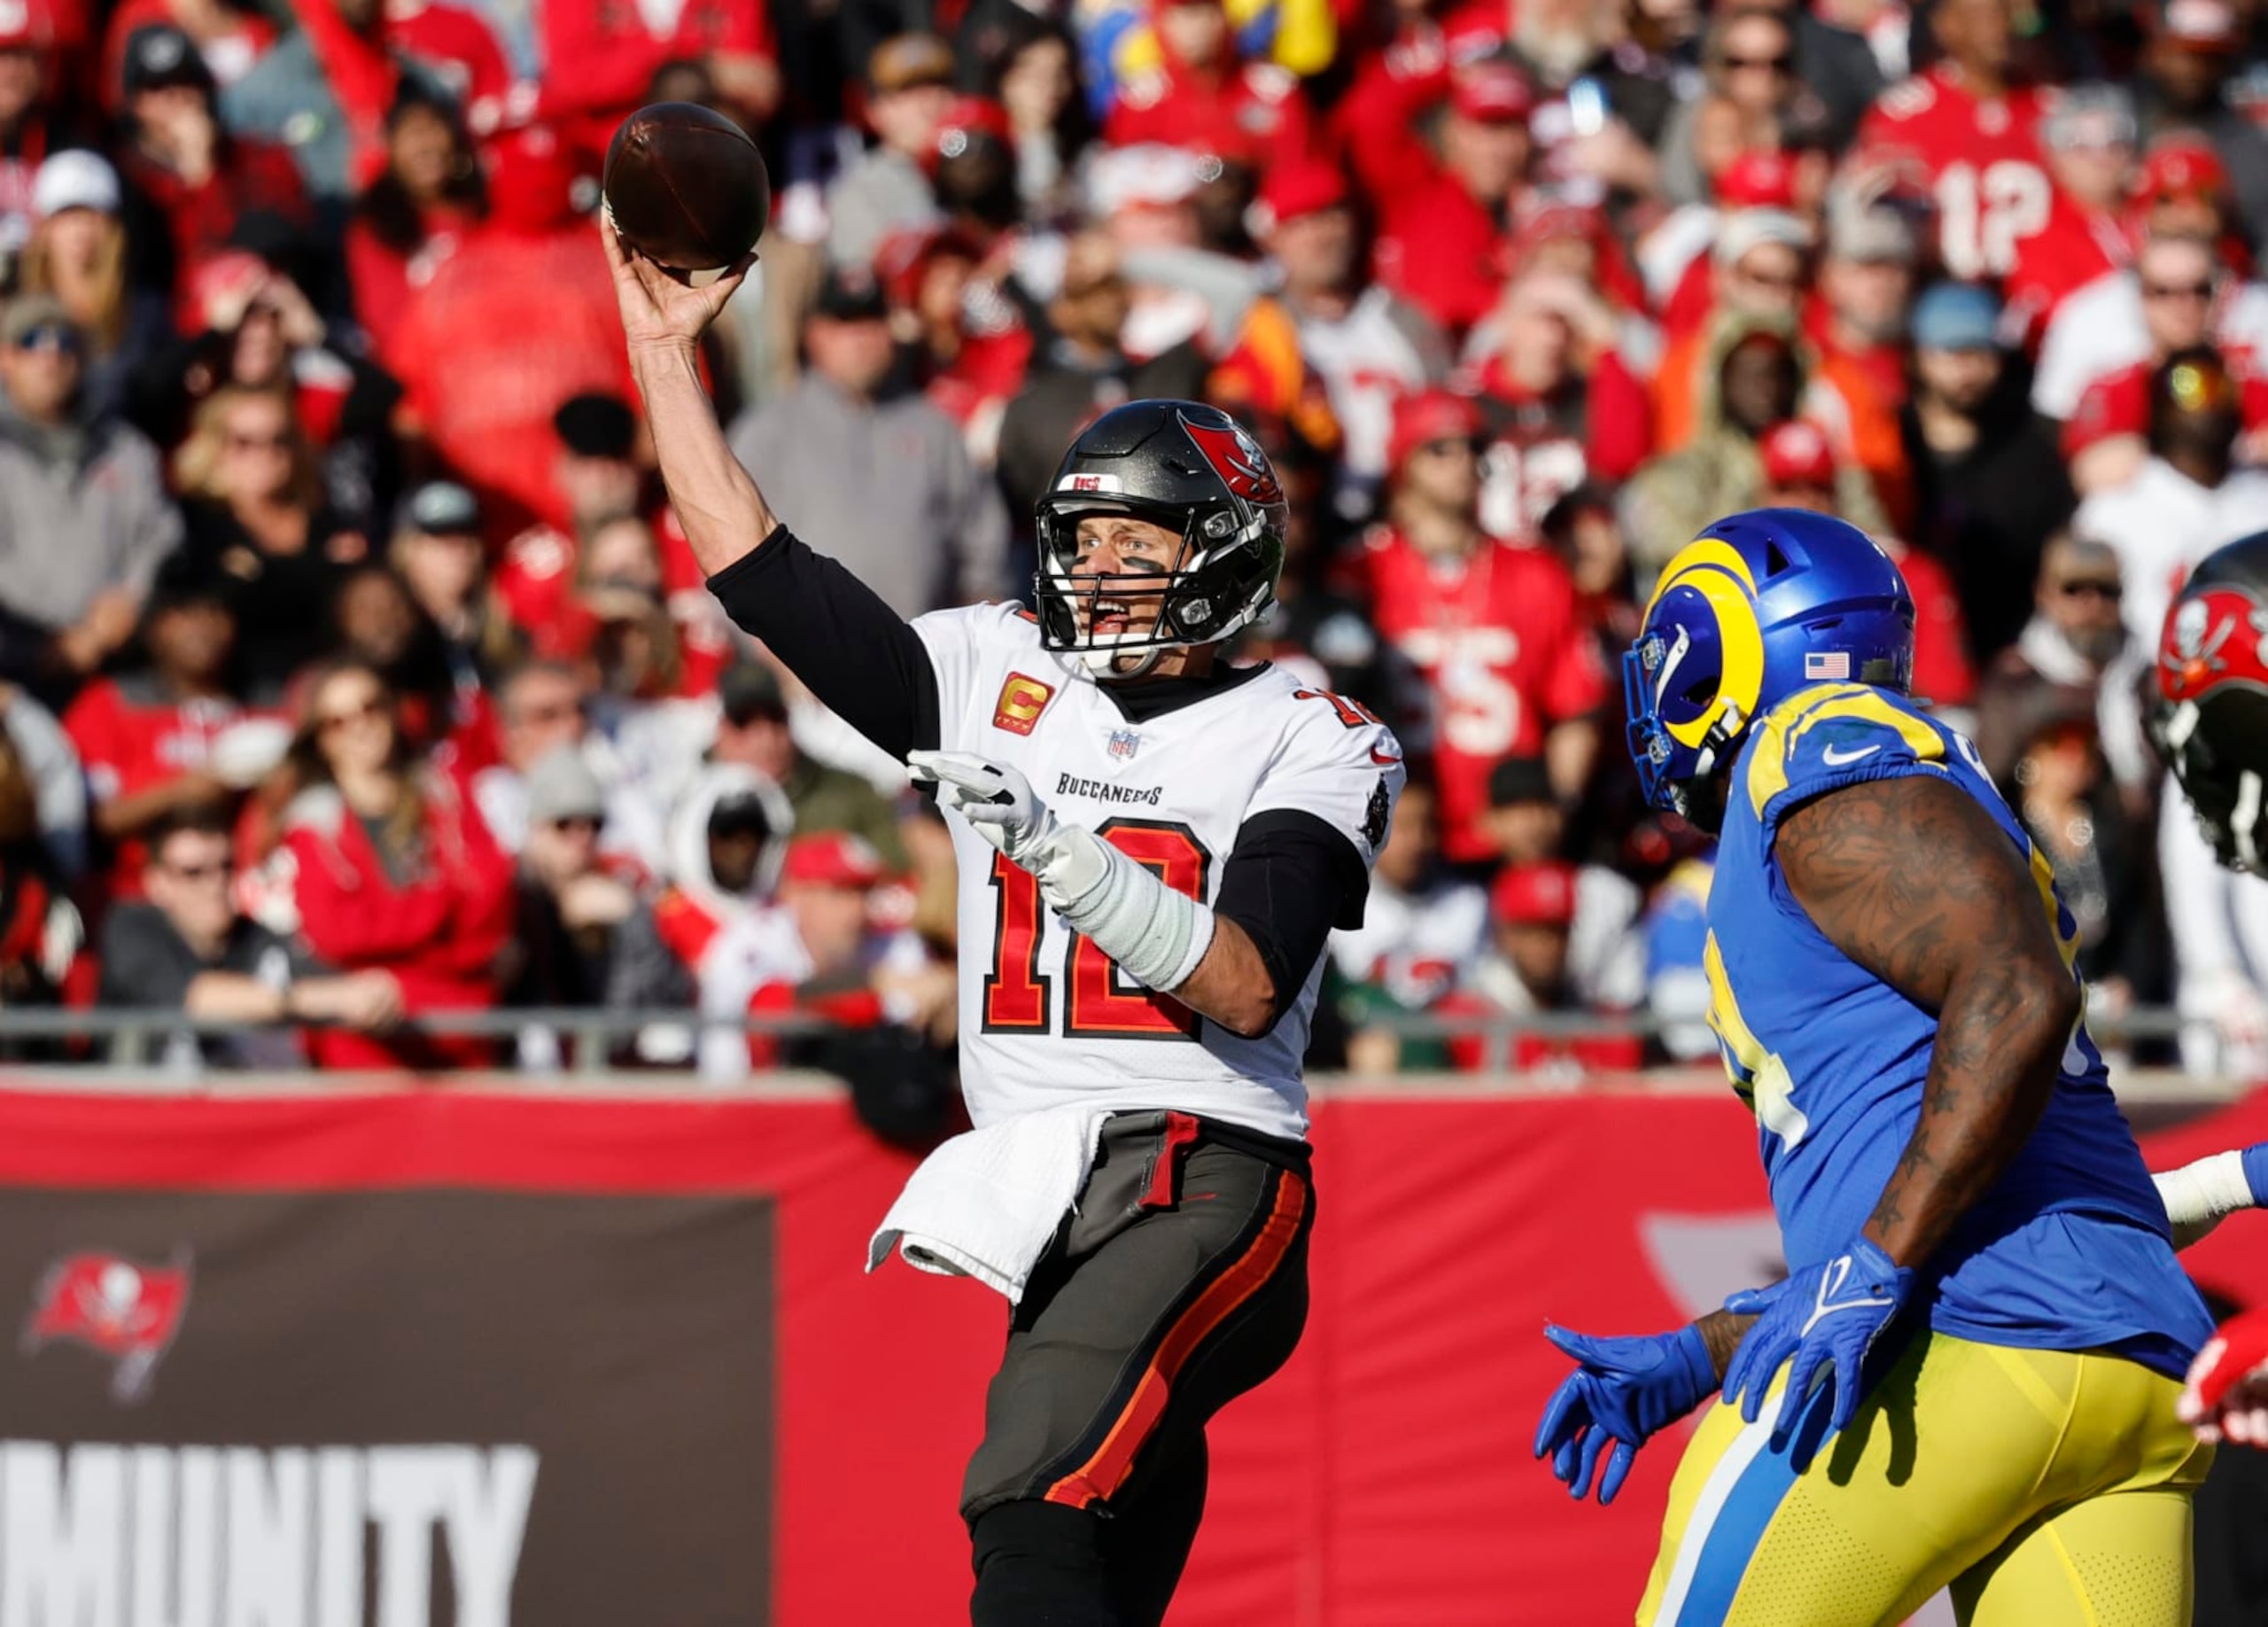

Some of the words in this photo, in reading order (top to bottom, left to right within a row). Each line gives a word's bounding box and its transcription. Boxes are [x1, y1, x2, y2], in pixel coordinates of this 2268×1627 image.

[1001, 678, 1048, 720] C
[1056, 772, 1162, 806] BUCCANEERS
[0, 1437, 540, 1627] MUNITY
